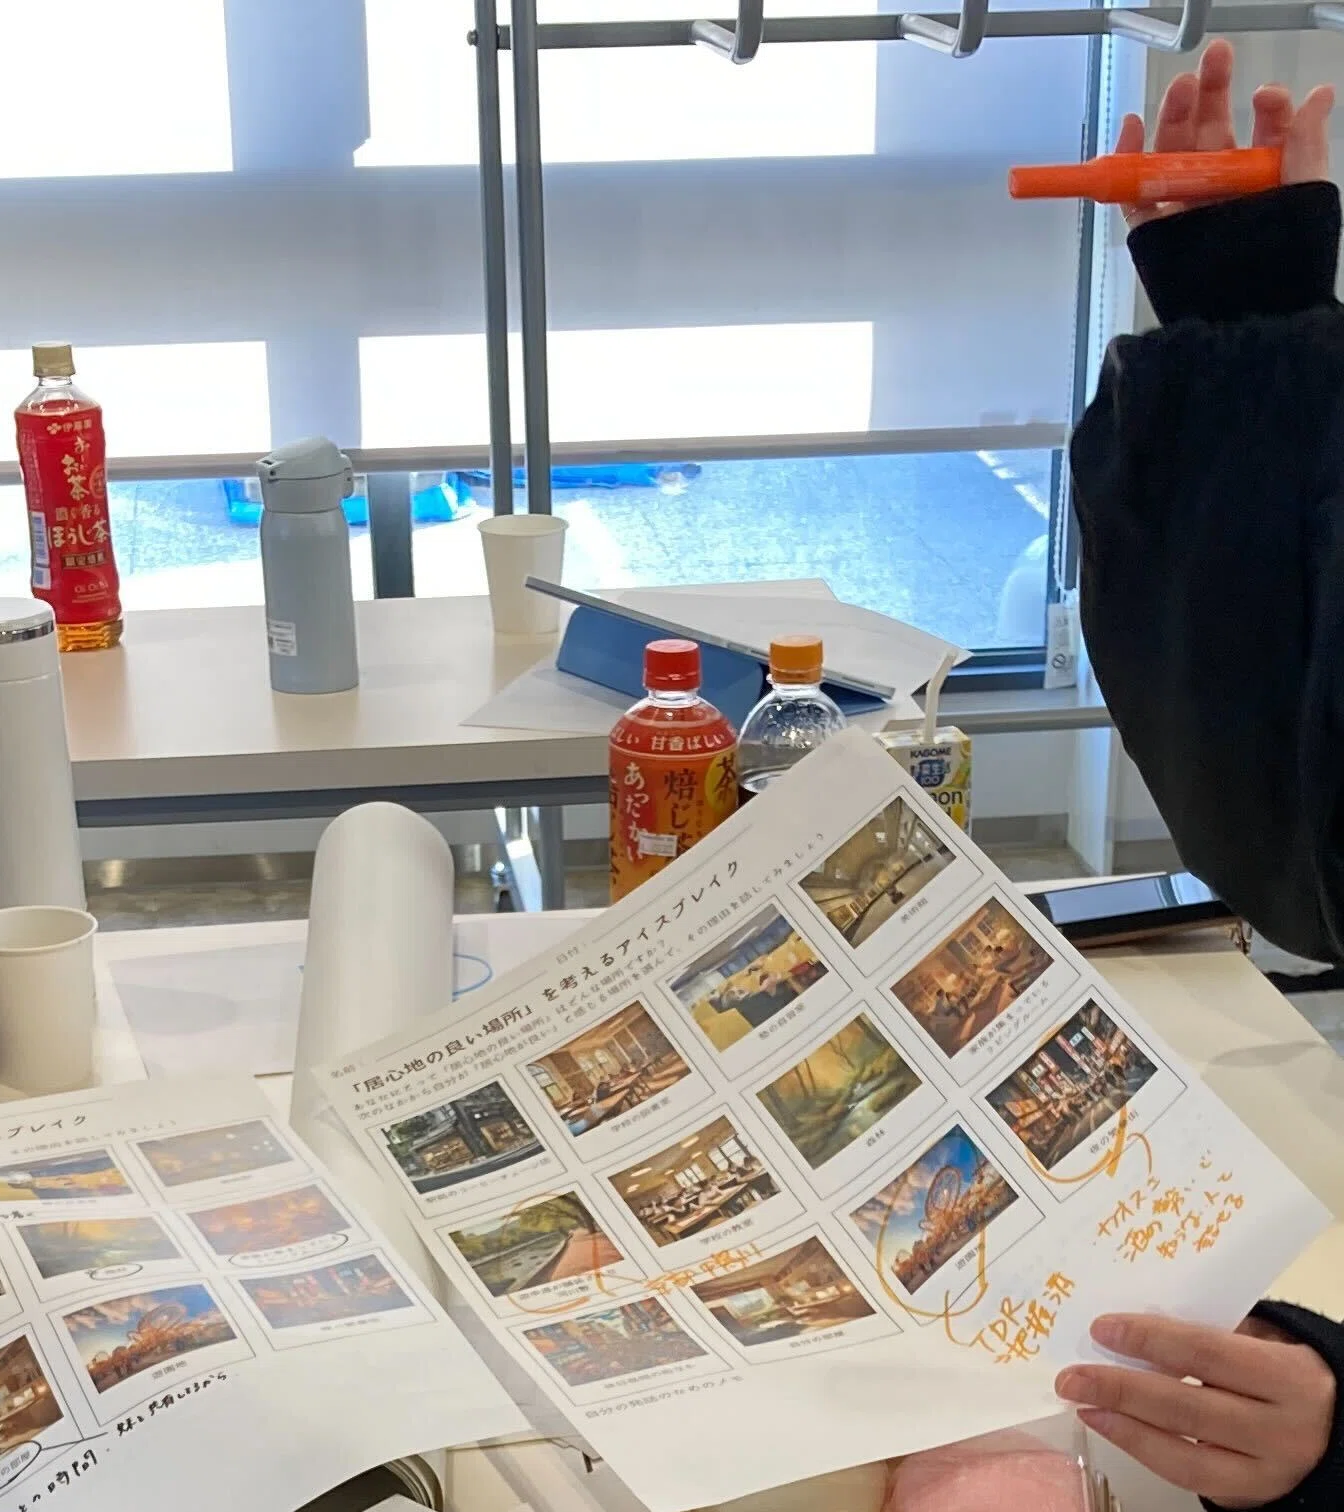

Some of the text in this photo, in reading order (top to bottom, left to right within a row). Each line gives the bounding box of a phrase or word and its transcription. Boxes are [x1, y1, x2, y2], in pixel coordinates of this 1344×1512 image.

[48, 519, 110, 548] ほうじ茶
[651, 732, 725, 752] 甘香ばしい
[910, 747, 952, 759] KAGOME
[352, 858, 740, 1094] 「居心地の良い場所」を考えるアイスブレイク
[865, 1127, 886, 1147] 森林
